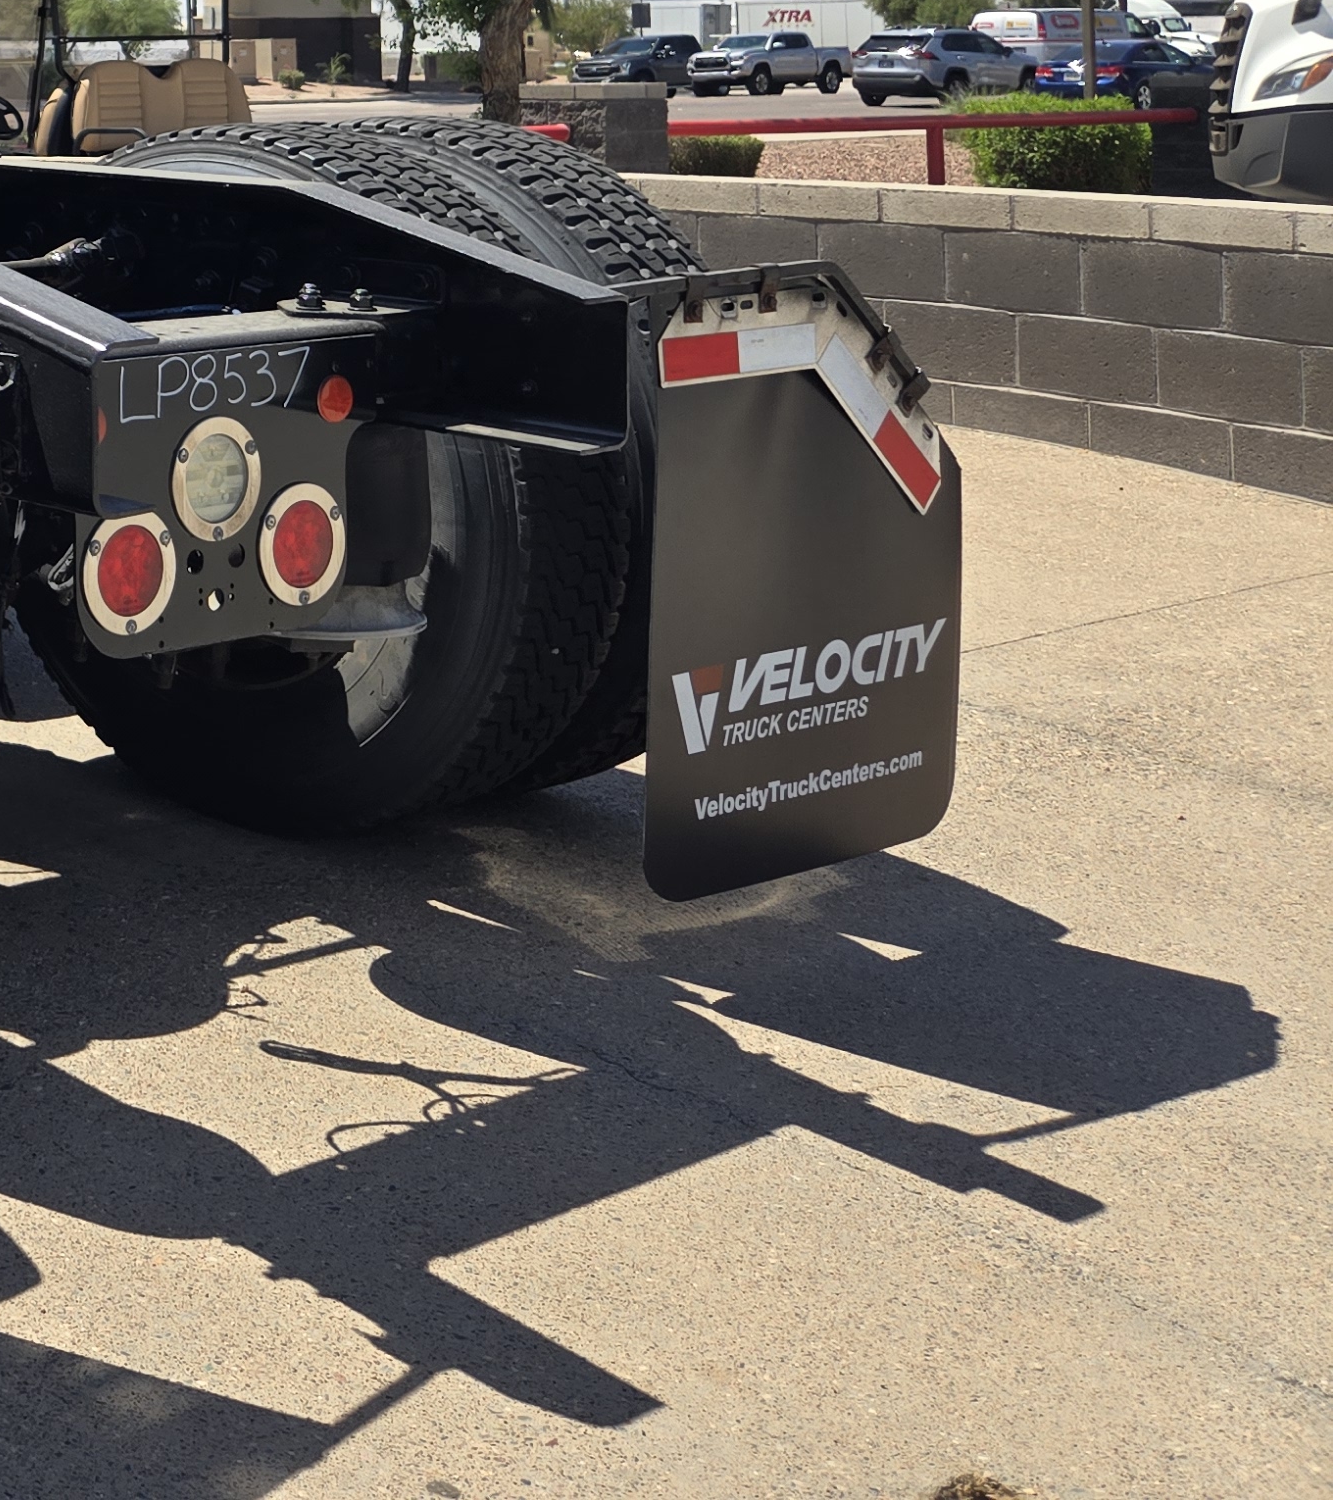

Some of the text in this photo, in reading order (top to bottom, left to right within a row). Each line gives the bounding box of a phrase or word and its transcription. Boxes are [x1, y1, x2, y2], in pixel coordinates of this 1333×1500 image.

[762, 8, 812, 27] XTRA
[119, 346, 310, 424] LP8537
[728, 617, 947, 713] VELOCITY
[722, 696, 869, 747] TRUCK CENTERS
[694, 750, 923, 820] VelocityTruckCenters.com
